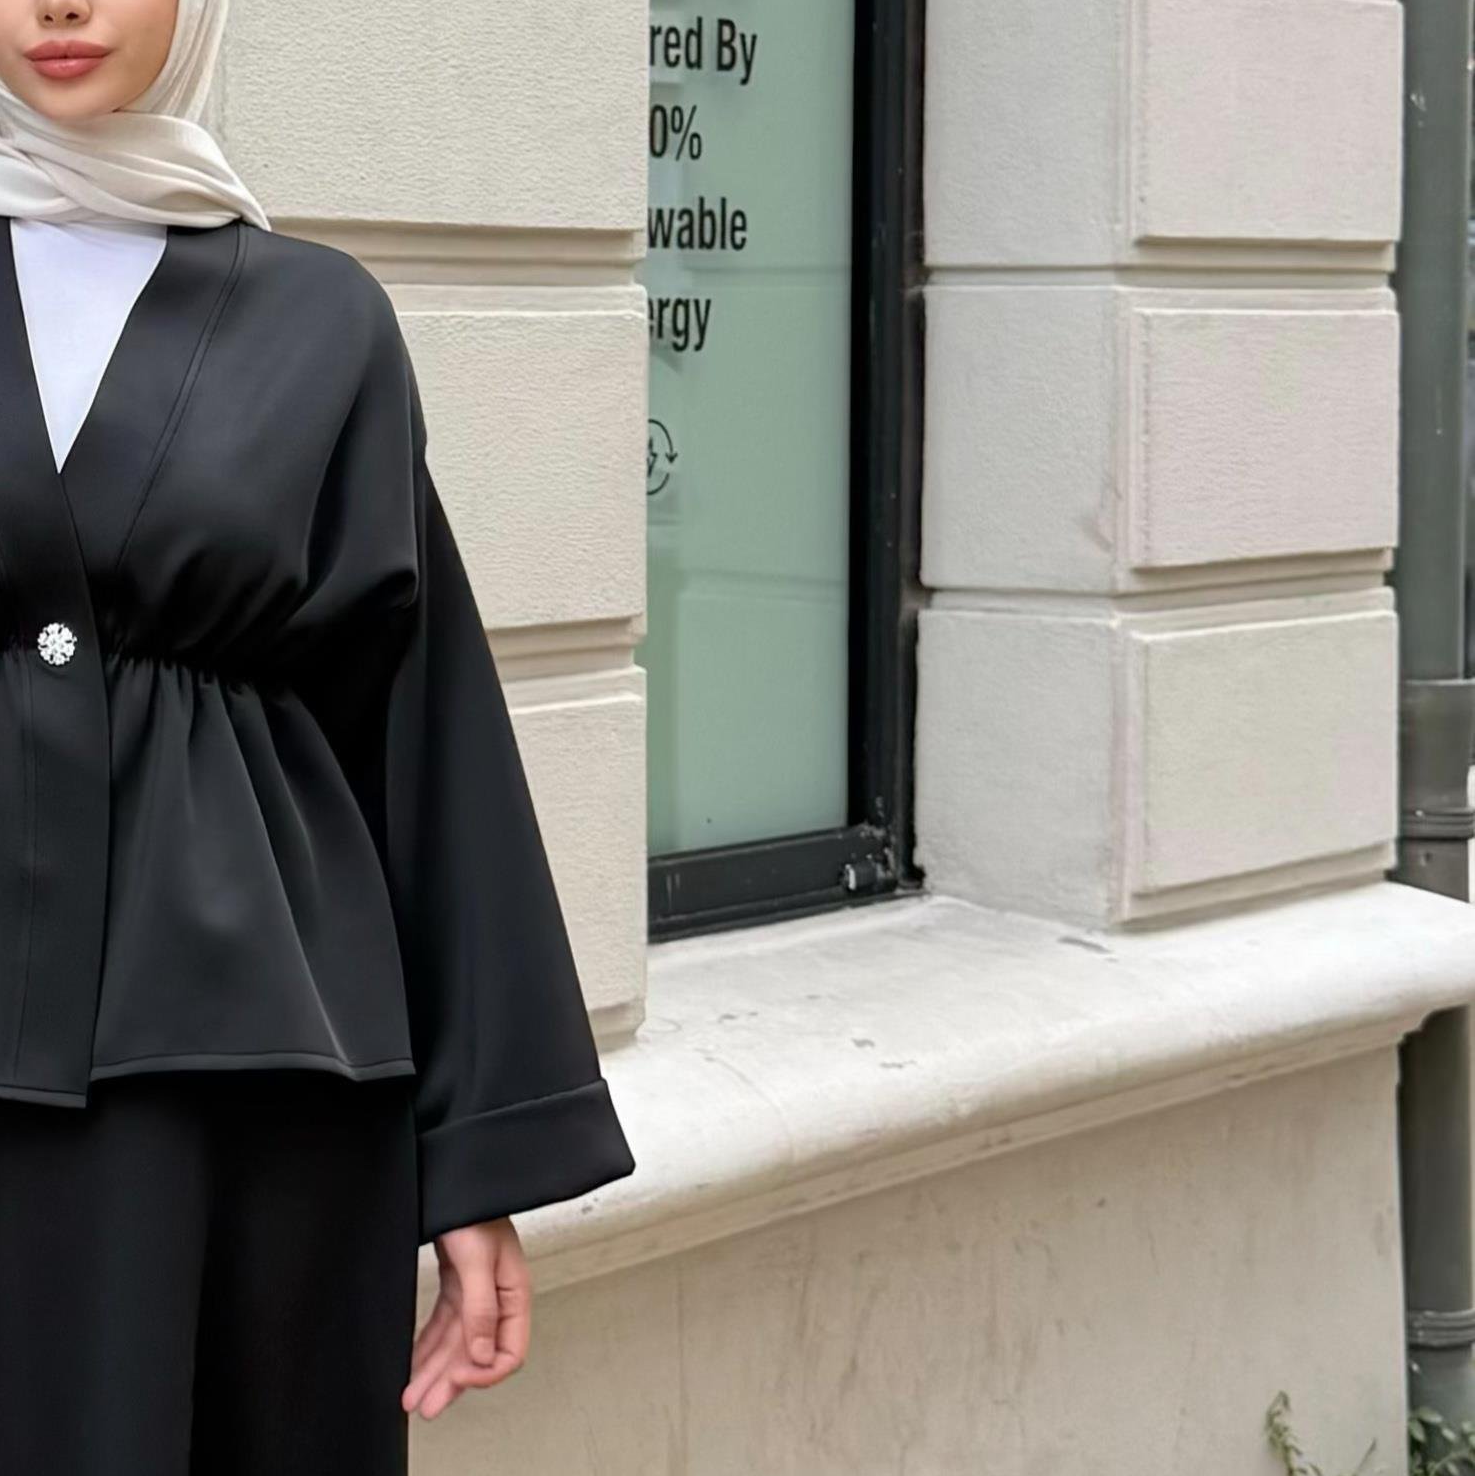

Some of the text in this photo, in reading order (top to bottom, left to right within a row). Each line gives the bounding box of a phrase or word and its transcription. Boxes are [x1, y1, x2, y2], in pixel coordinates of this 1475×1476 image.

[650, 16, 757, 85] red By
[649, 104, 702, 161] 0%
[648, 196, 747, 251] wable
